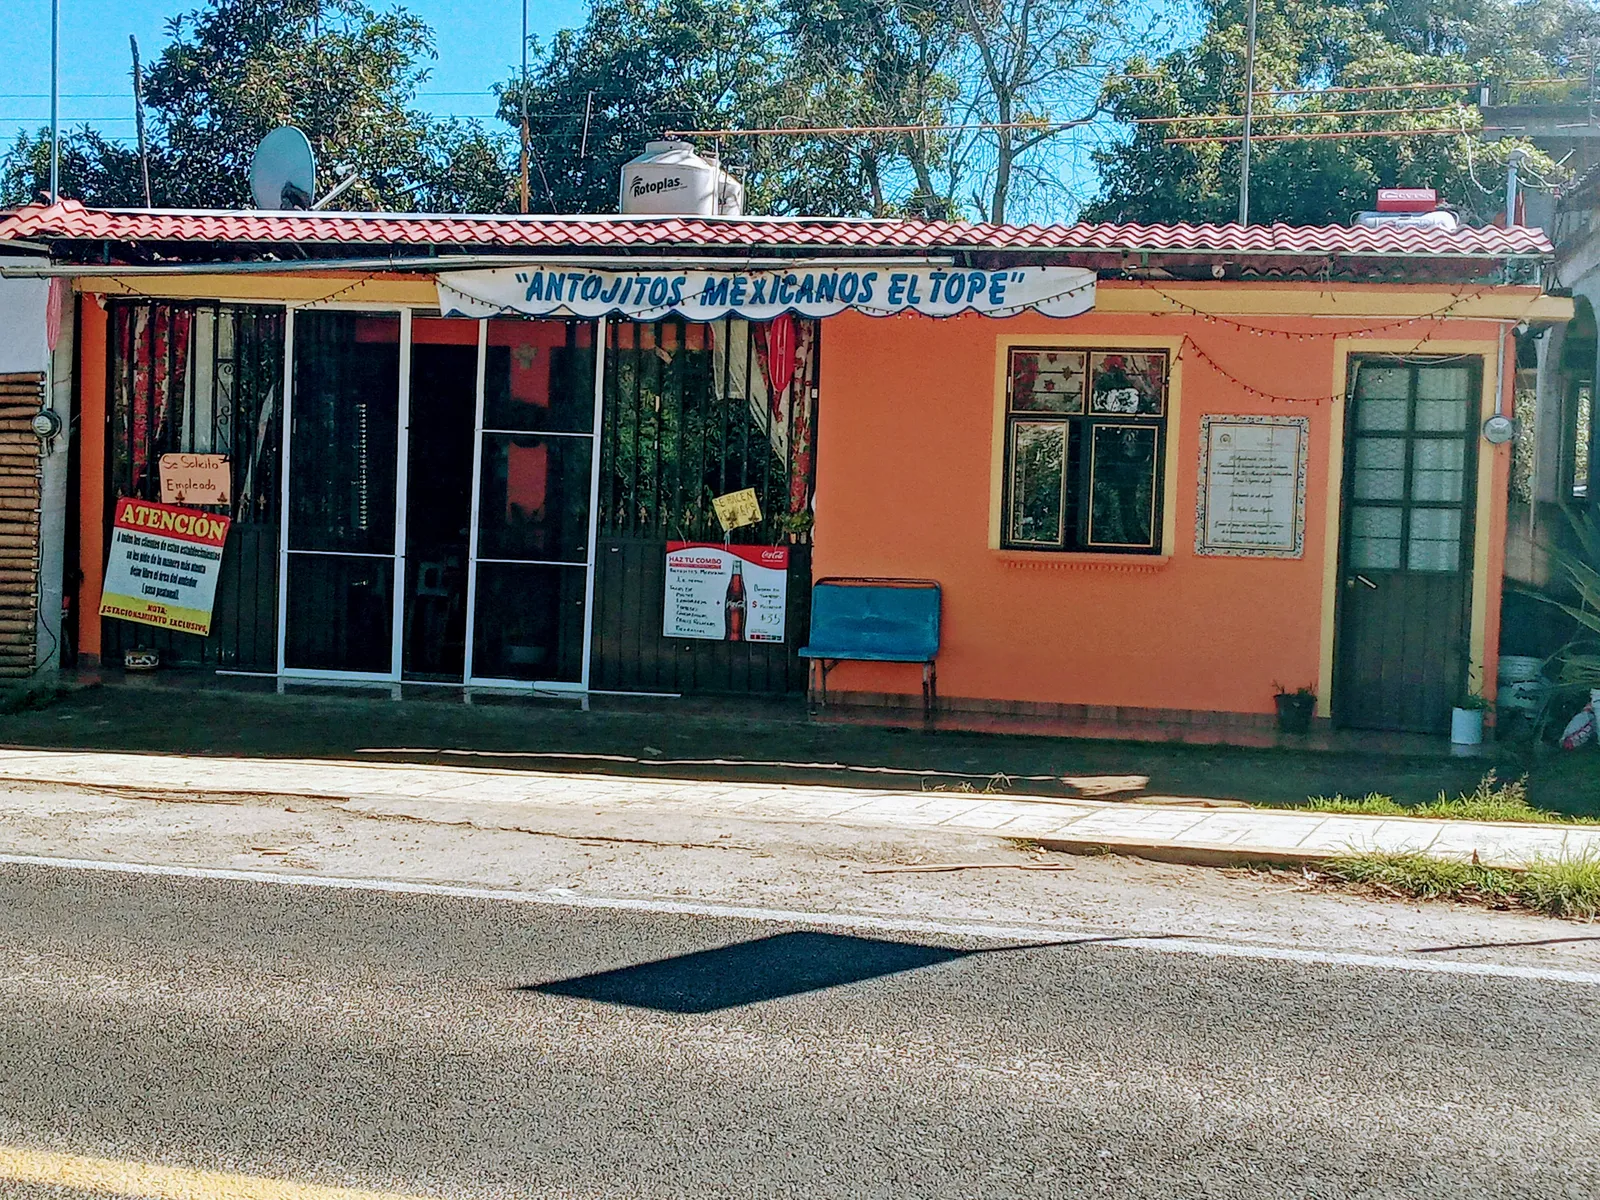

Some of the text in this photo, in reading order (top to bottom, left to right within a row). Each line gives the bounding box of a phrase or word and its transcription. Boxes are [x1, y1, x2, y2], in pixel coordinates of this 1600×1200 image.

[633, 177, 681, 198] Rotoplas
[699, 271, 878, 307] MEXICANOS
[888, 273, 921, 306] EL
[120, 503, 226, 541] ATENCIÓN
[695, 557, 722, 565] COMBO
